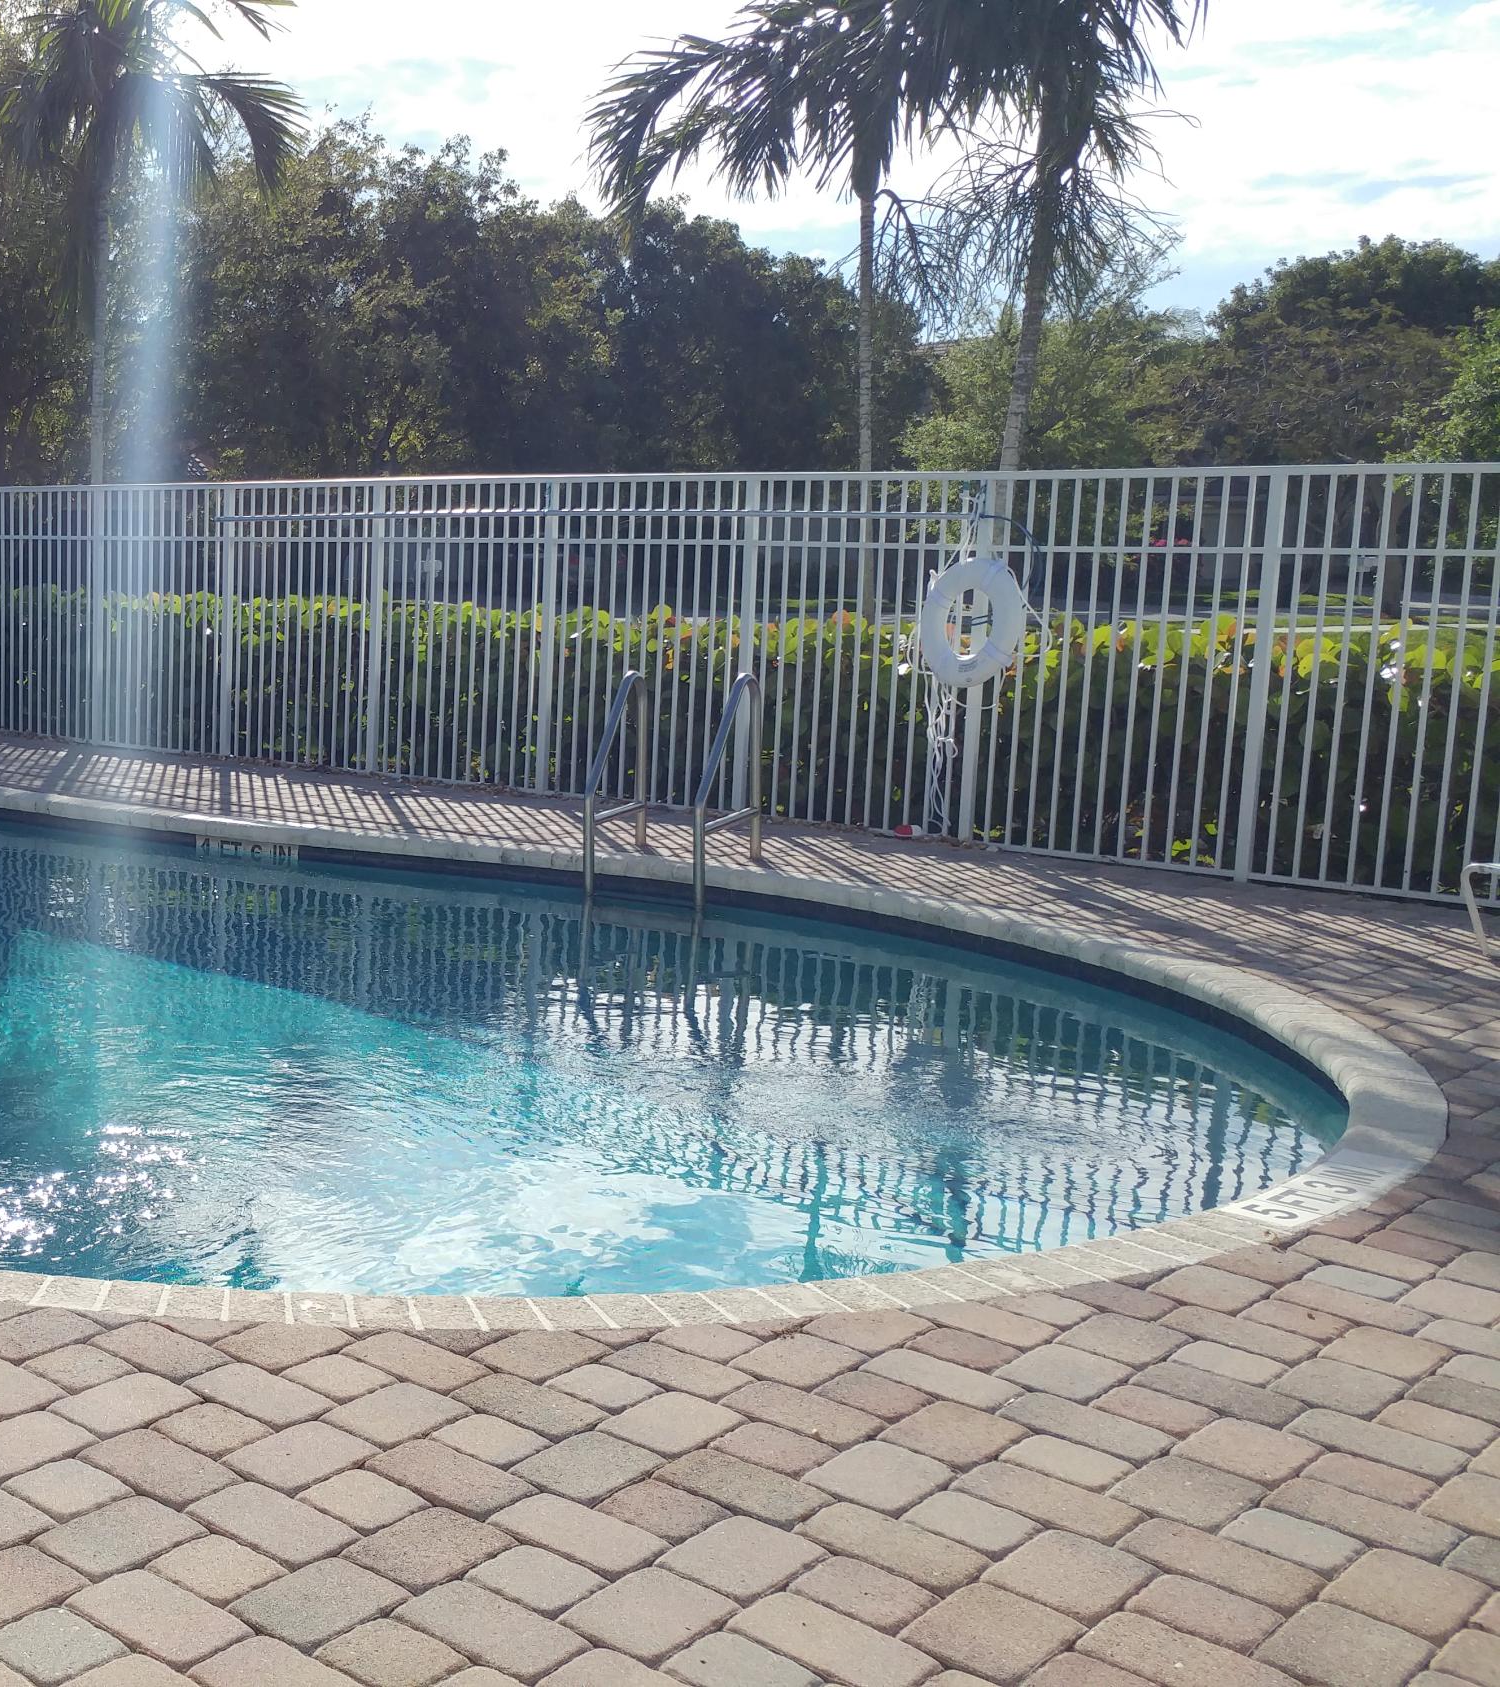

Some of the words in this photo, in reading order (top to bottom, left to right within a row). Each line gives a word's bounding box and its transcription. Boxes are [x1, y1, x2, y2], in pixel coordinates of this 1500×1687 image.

[220, 839, 242, 855] FT
[272, 844, 292, 858] IN
[1241, 1203, 1299, 1220] 5
[1302, 1180, 1358, 1195] 3
